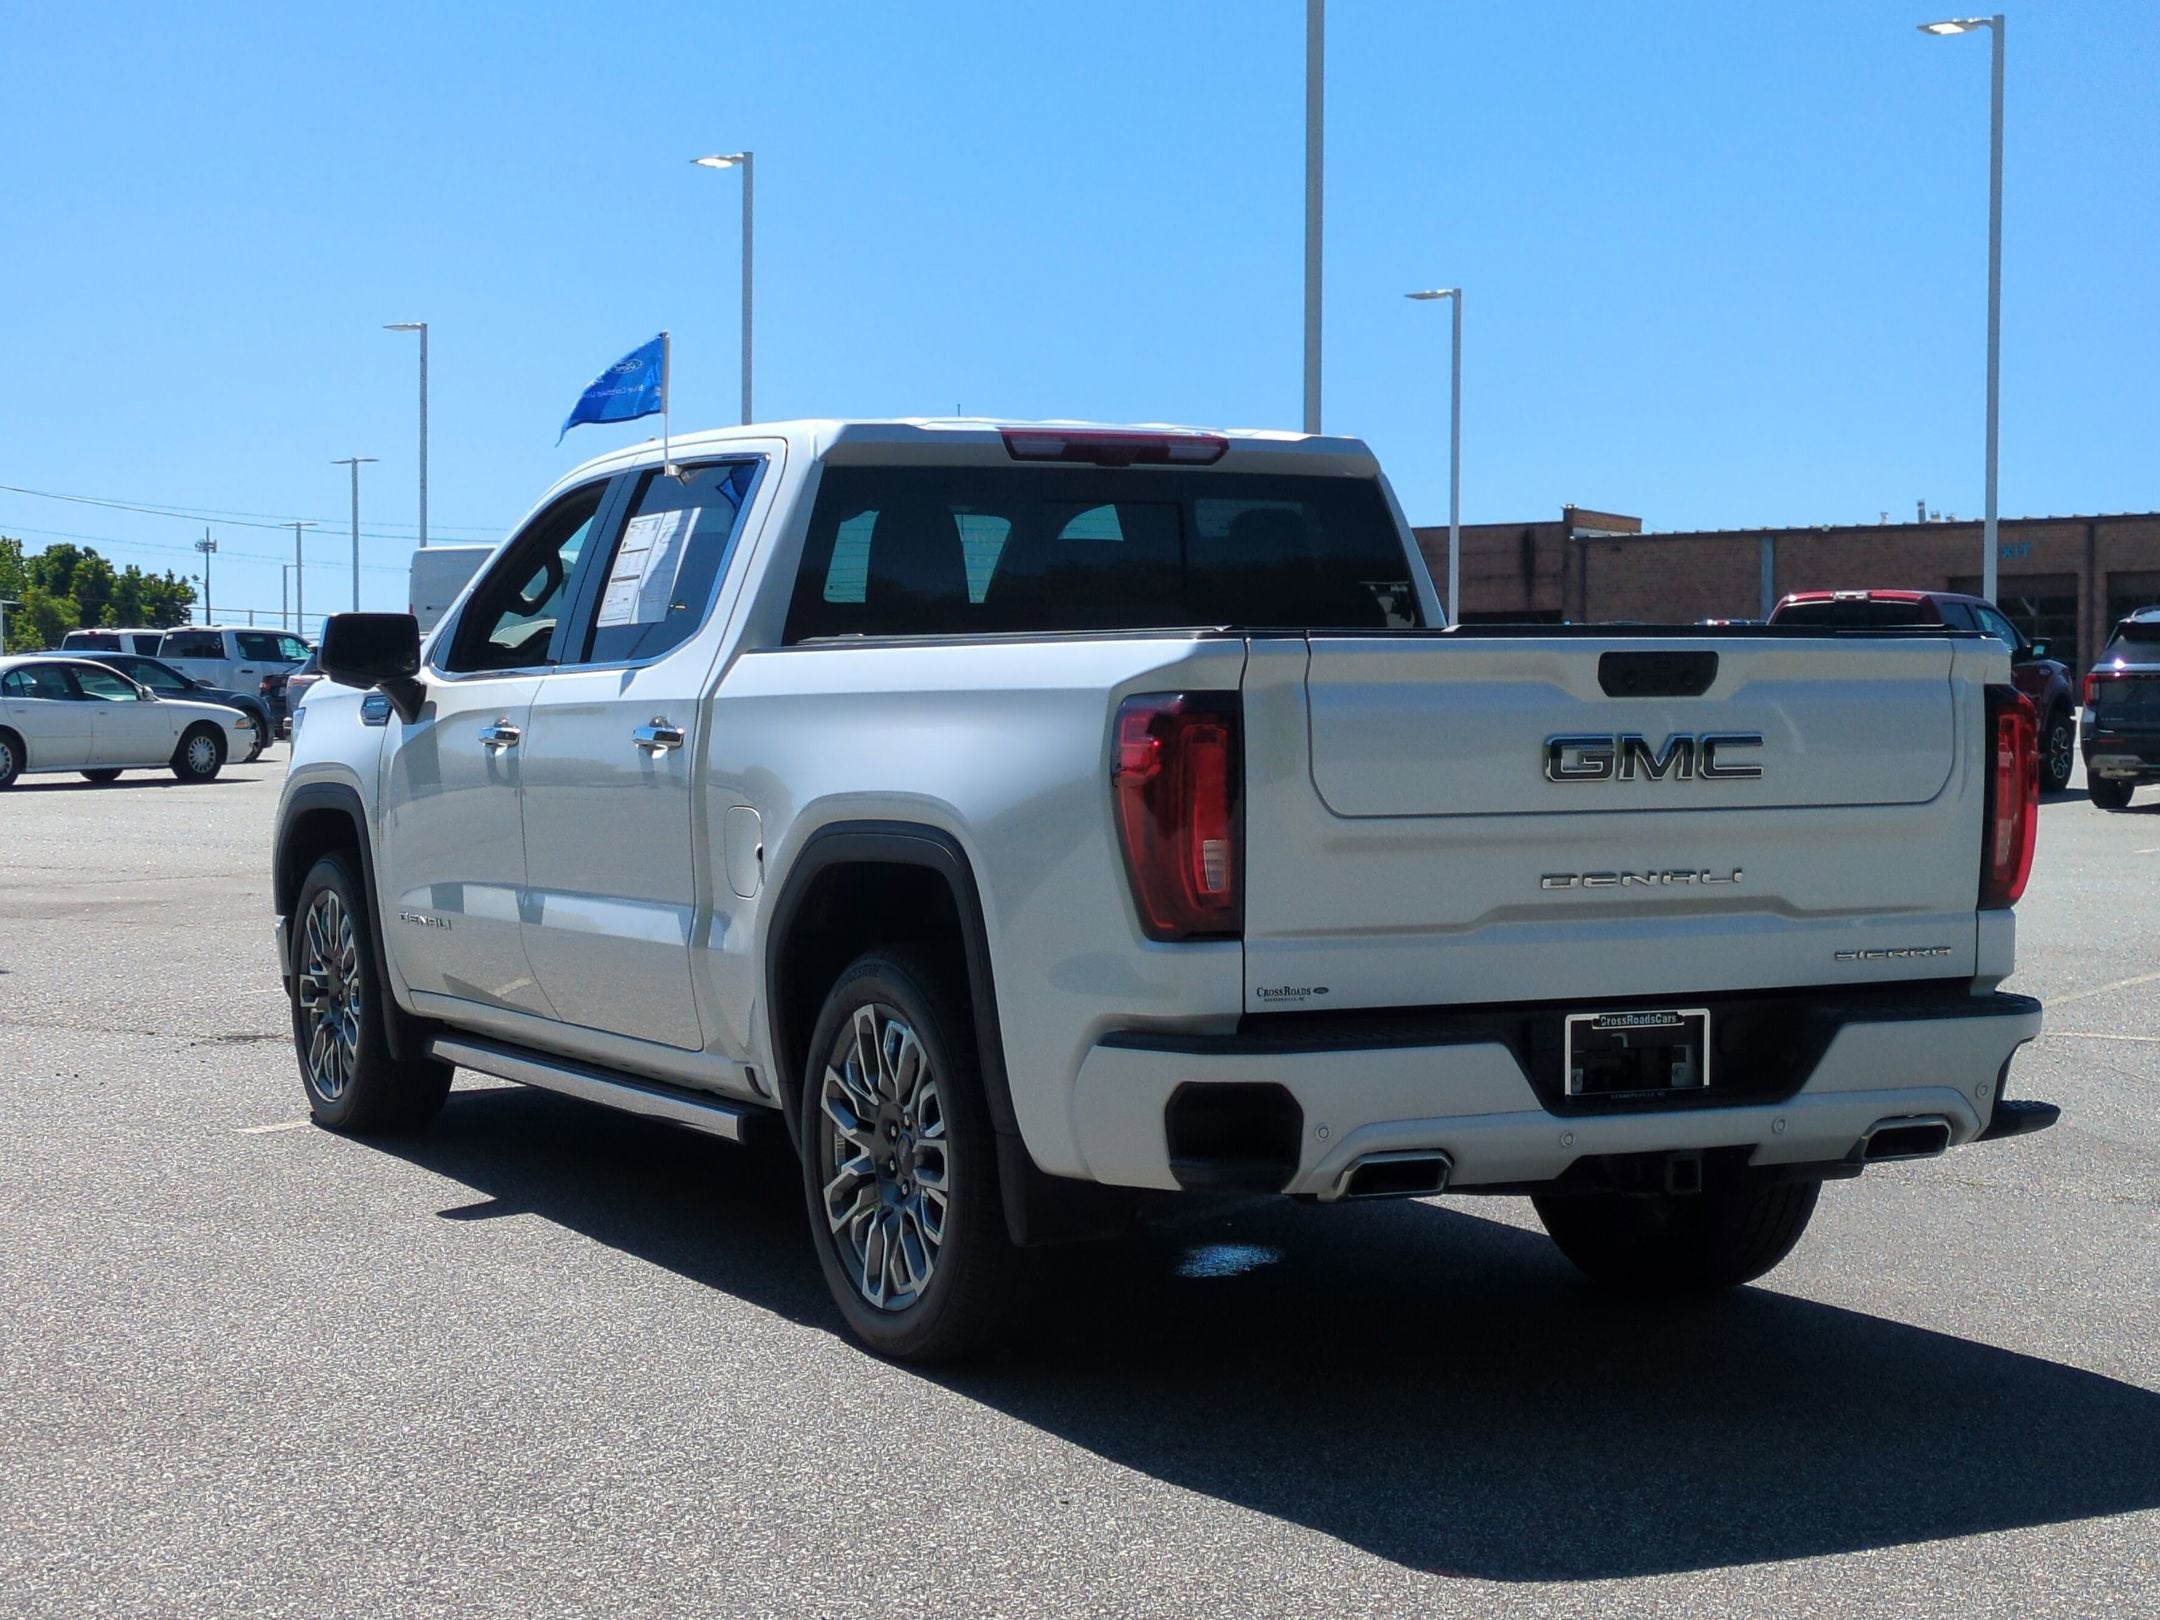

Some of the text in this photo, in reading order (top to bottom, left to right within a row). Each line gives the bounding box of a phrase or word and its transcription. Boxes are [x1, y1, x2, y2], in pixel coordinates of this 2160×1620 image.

[1545, 732, 1764, 782] GMC
[1541, 867, 1744, 890] DENALI
[1834, 945, 1952, 961] SIERRA
